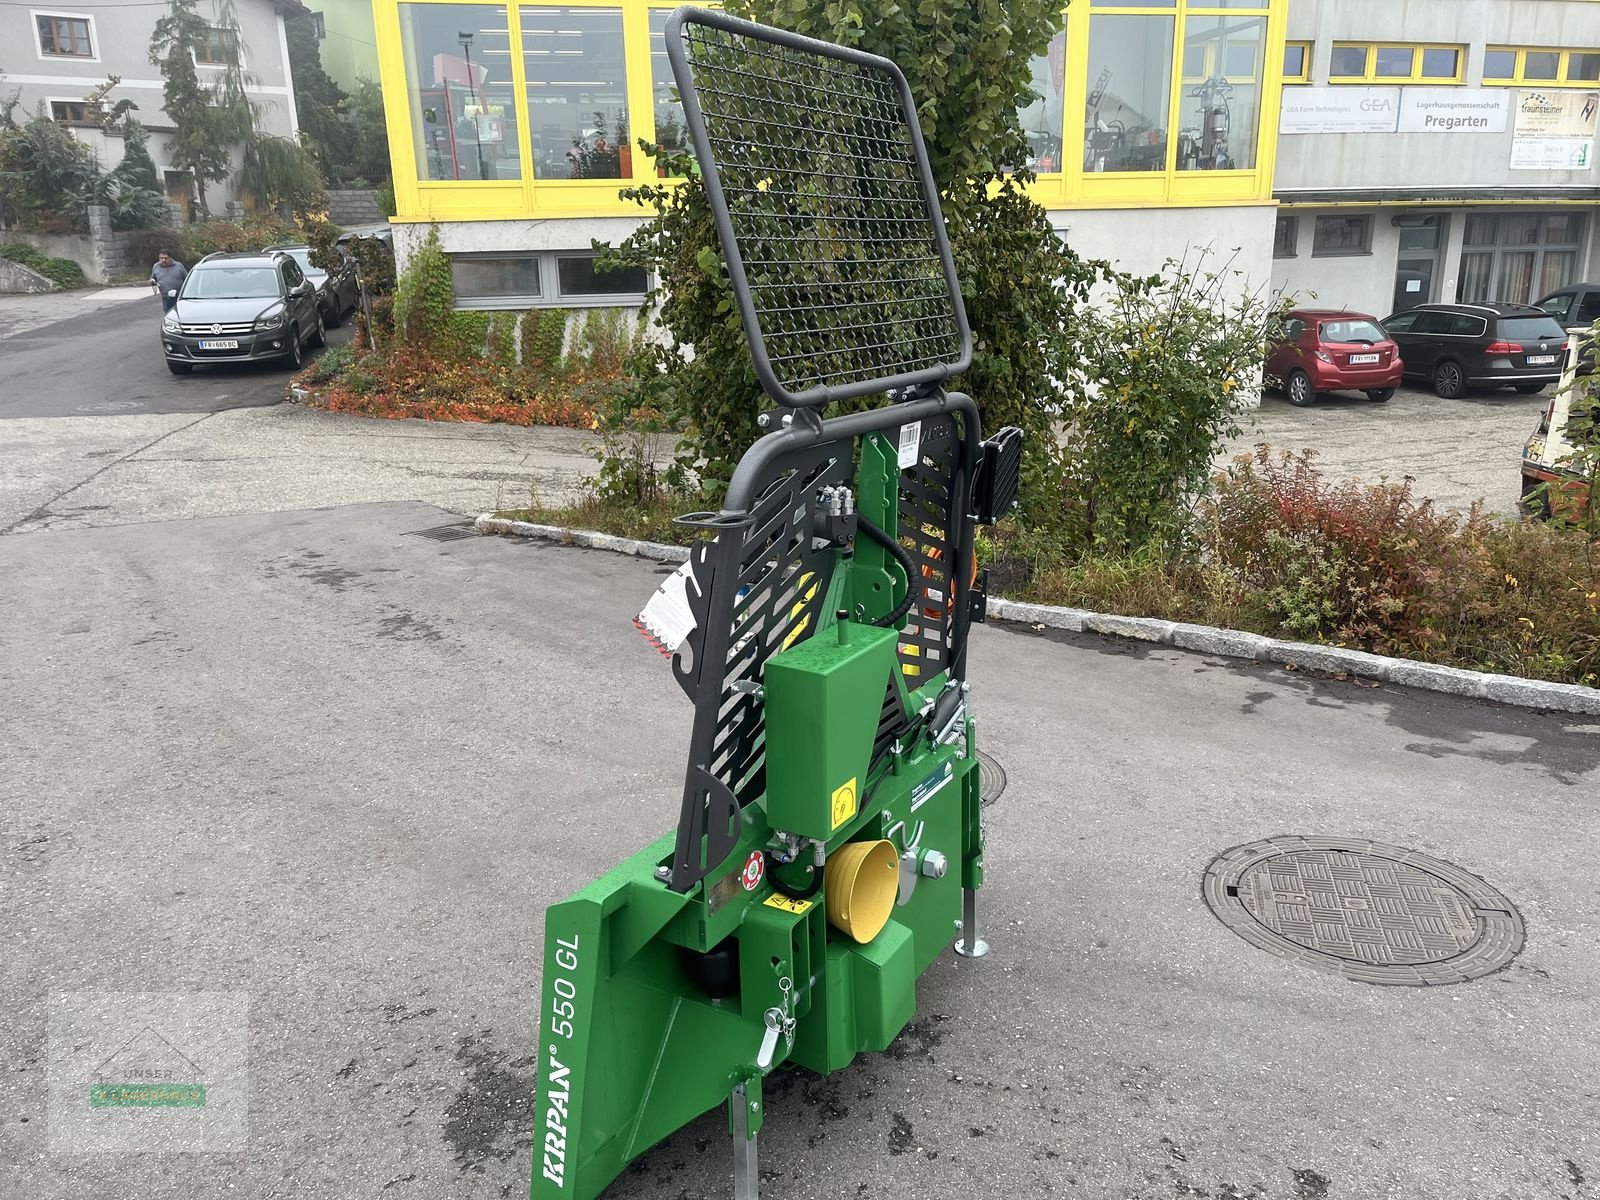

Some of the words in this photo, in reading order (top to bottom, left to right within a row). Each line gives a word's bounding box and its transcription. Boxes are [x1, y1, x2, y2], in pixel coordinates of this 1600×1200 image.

[1315, 105, 1351, 115] Technologies
[1360, 98, 1392, 112] GEA
[1416, 100, 1500, 111] Lagerhausgenossenschaft
[1521, 103, 1563, 114] traunsteiner
[1424, 114, 1489, 130] Pregarten
[555, 934, 579, 971] GL
[551, 978, 576, 1039] 550
